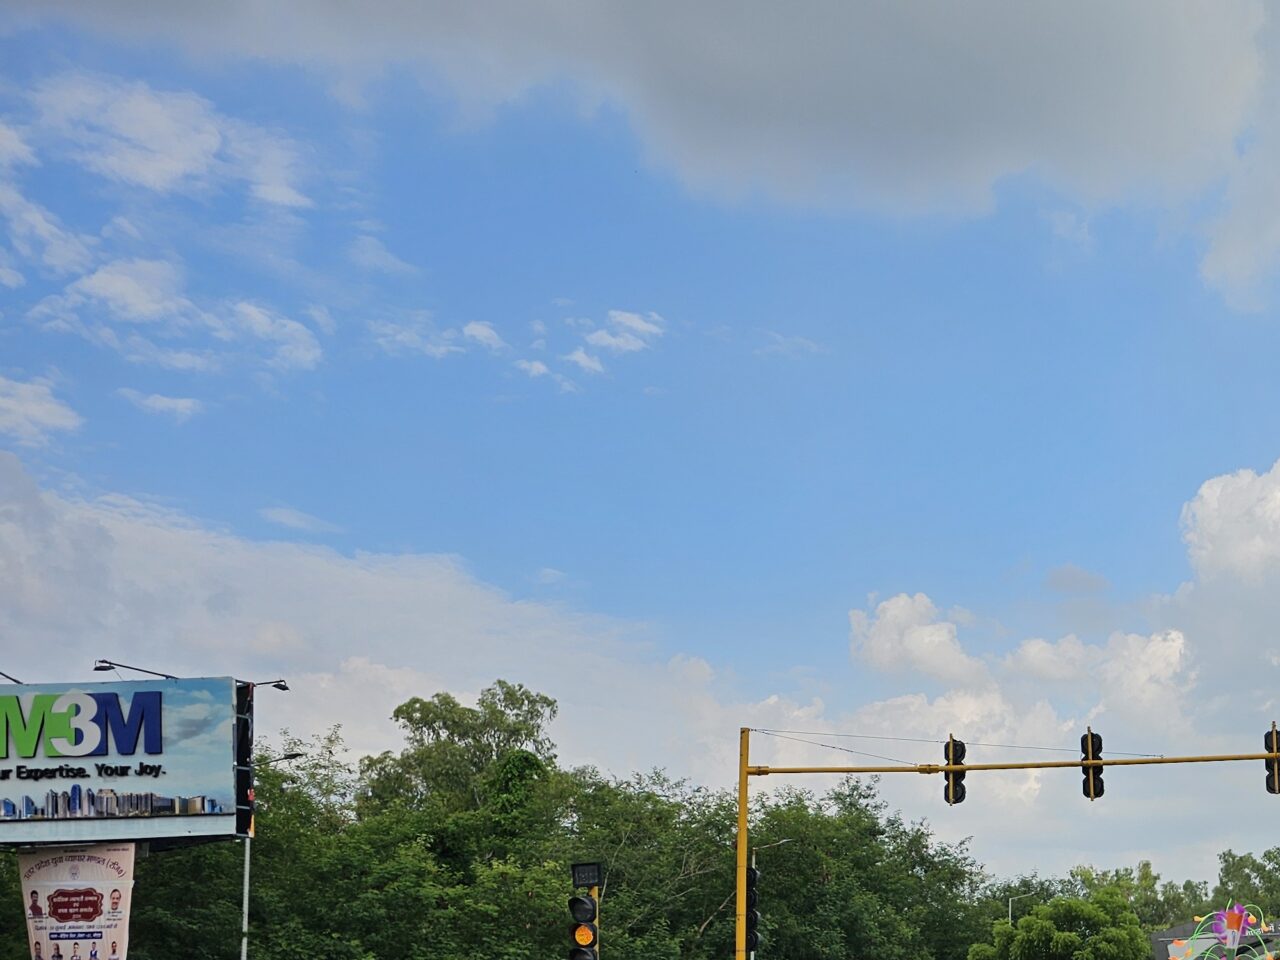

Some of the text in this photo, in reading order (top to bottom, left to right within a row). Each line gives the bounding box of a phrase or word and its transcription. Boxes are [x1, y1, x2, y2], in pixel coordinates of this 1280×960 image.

[0, 691, 162, 758] M3M
[16, 764, 90, 781] Expertise.
[95, 763, 131, 778] Your
[135, 762, 166, 778] Joy.
